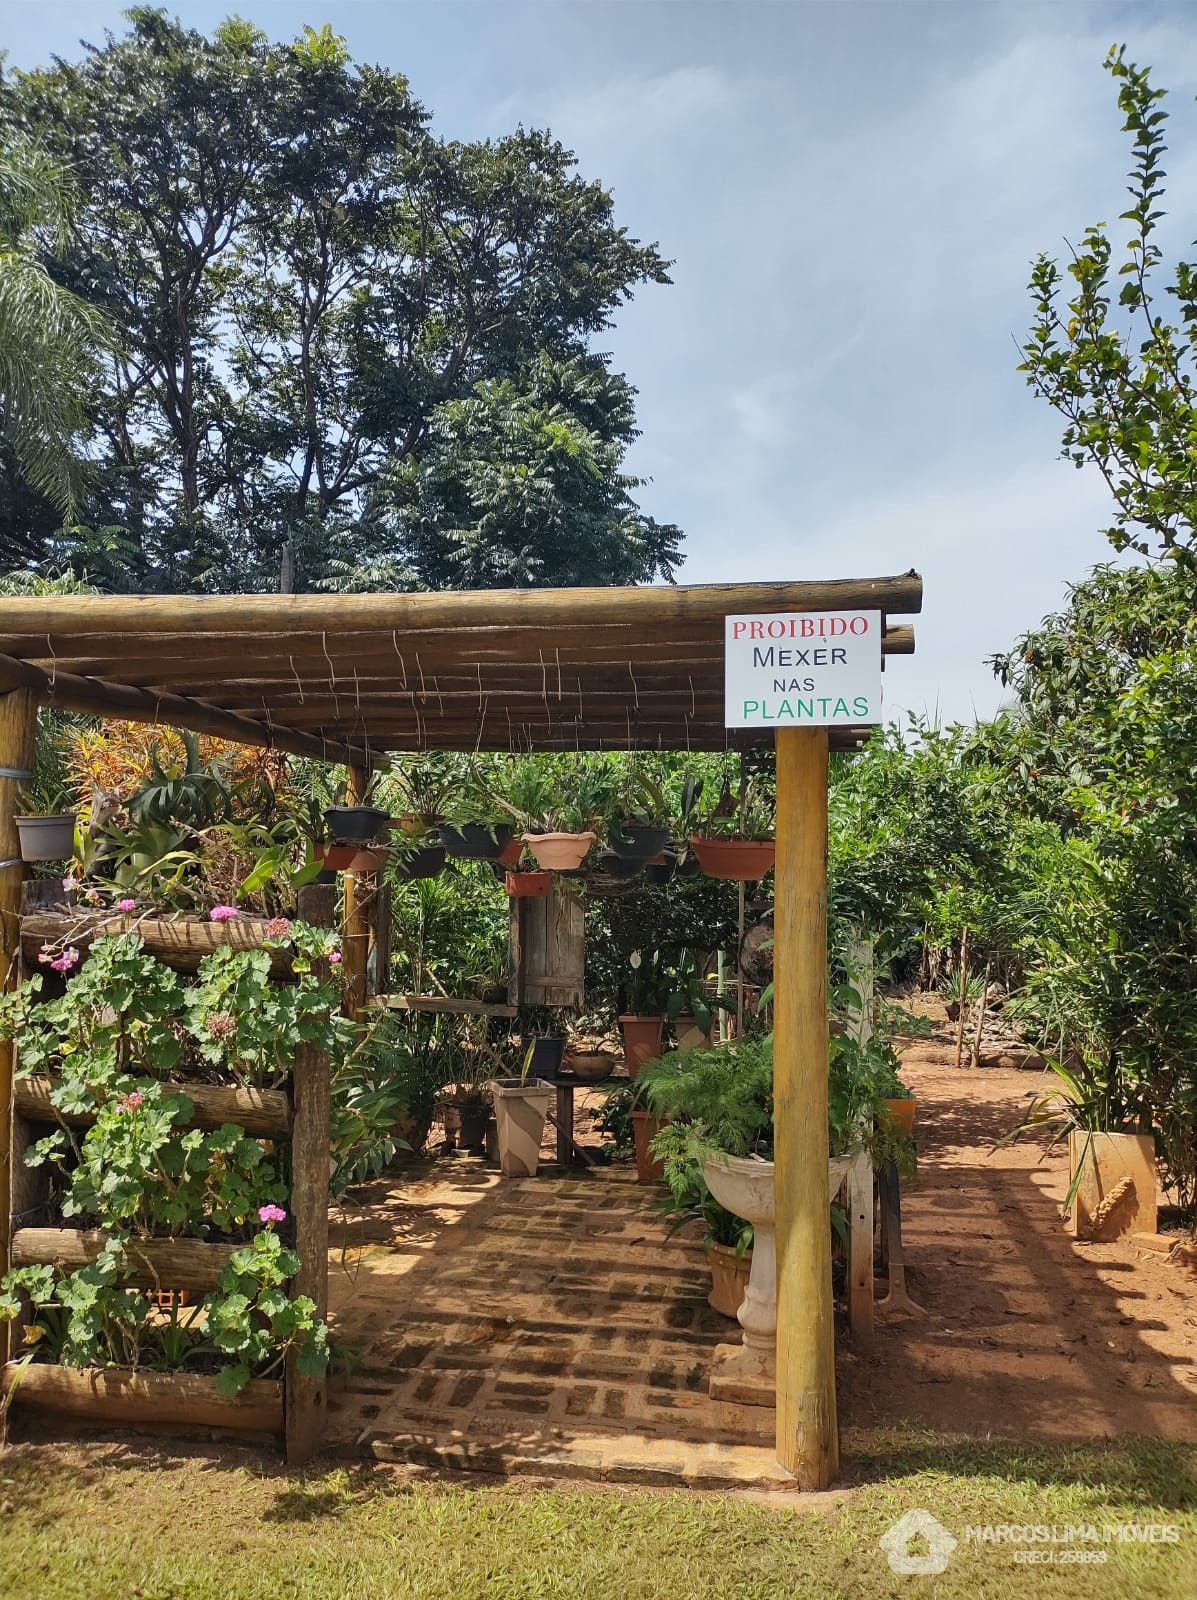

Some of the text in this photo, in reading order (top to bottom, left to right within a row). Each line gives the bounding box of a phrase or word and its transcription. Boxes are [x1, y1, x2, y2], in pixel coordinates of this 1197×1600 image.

[732, 616, 869, 640] PROIBIDO
[753, 646, 848, 668] MEXER
[773, 677, 815, 693] NAS
[743, 696, 869, 720] PLANTAS
